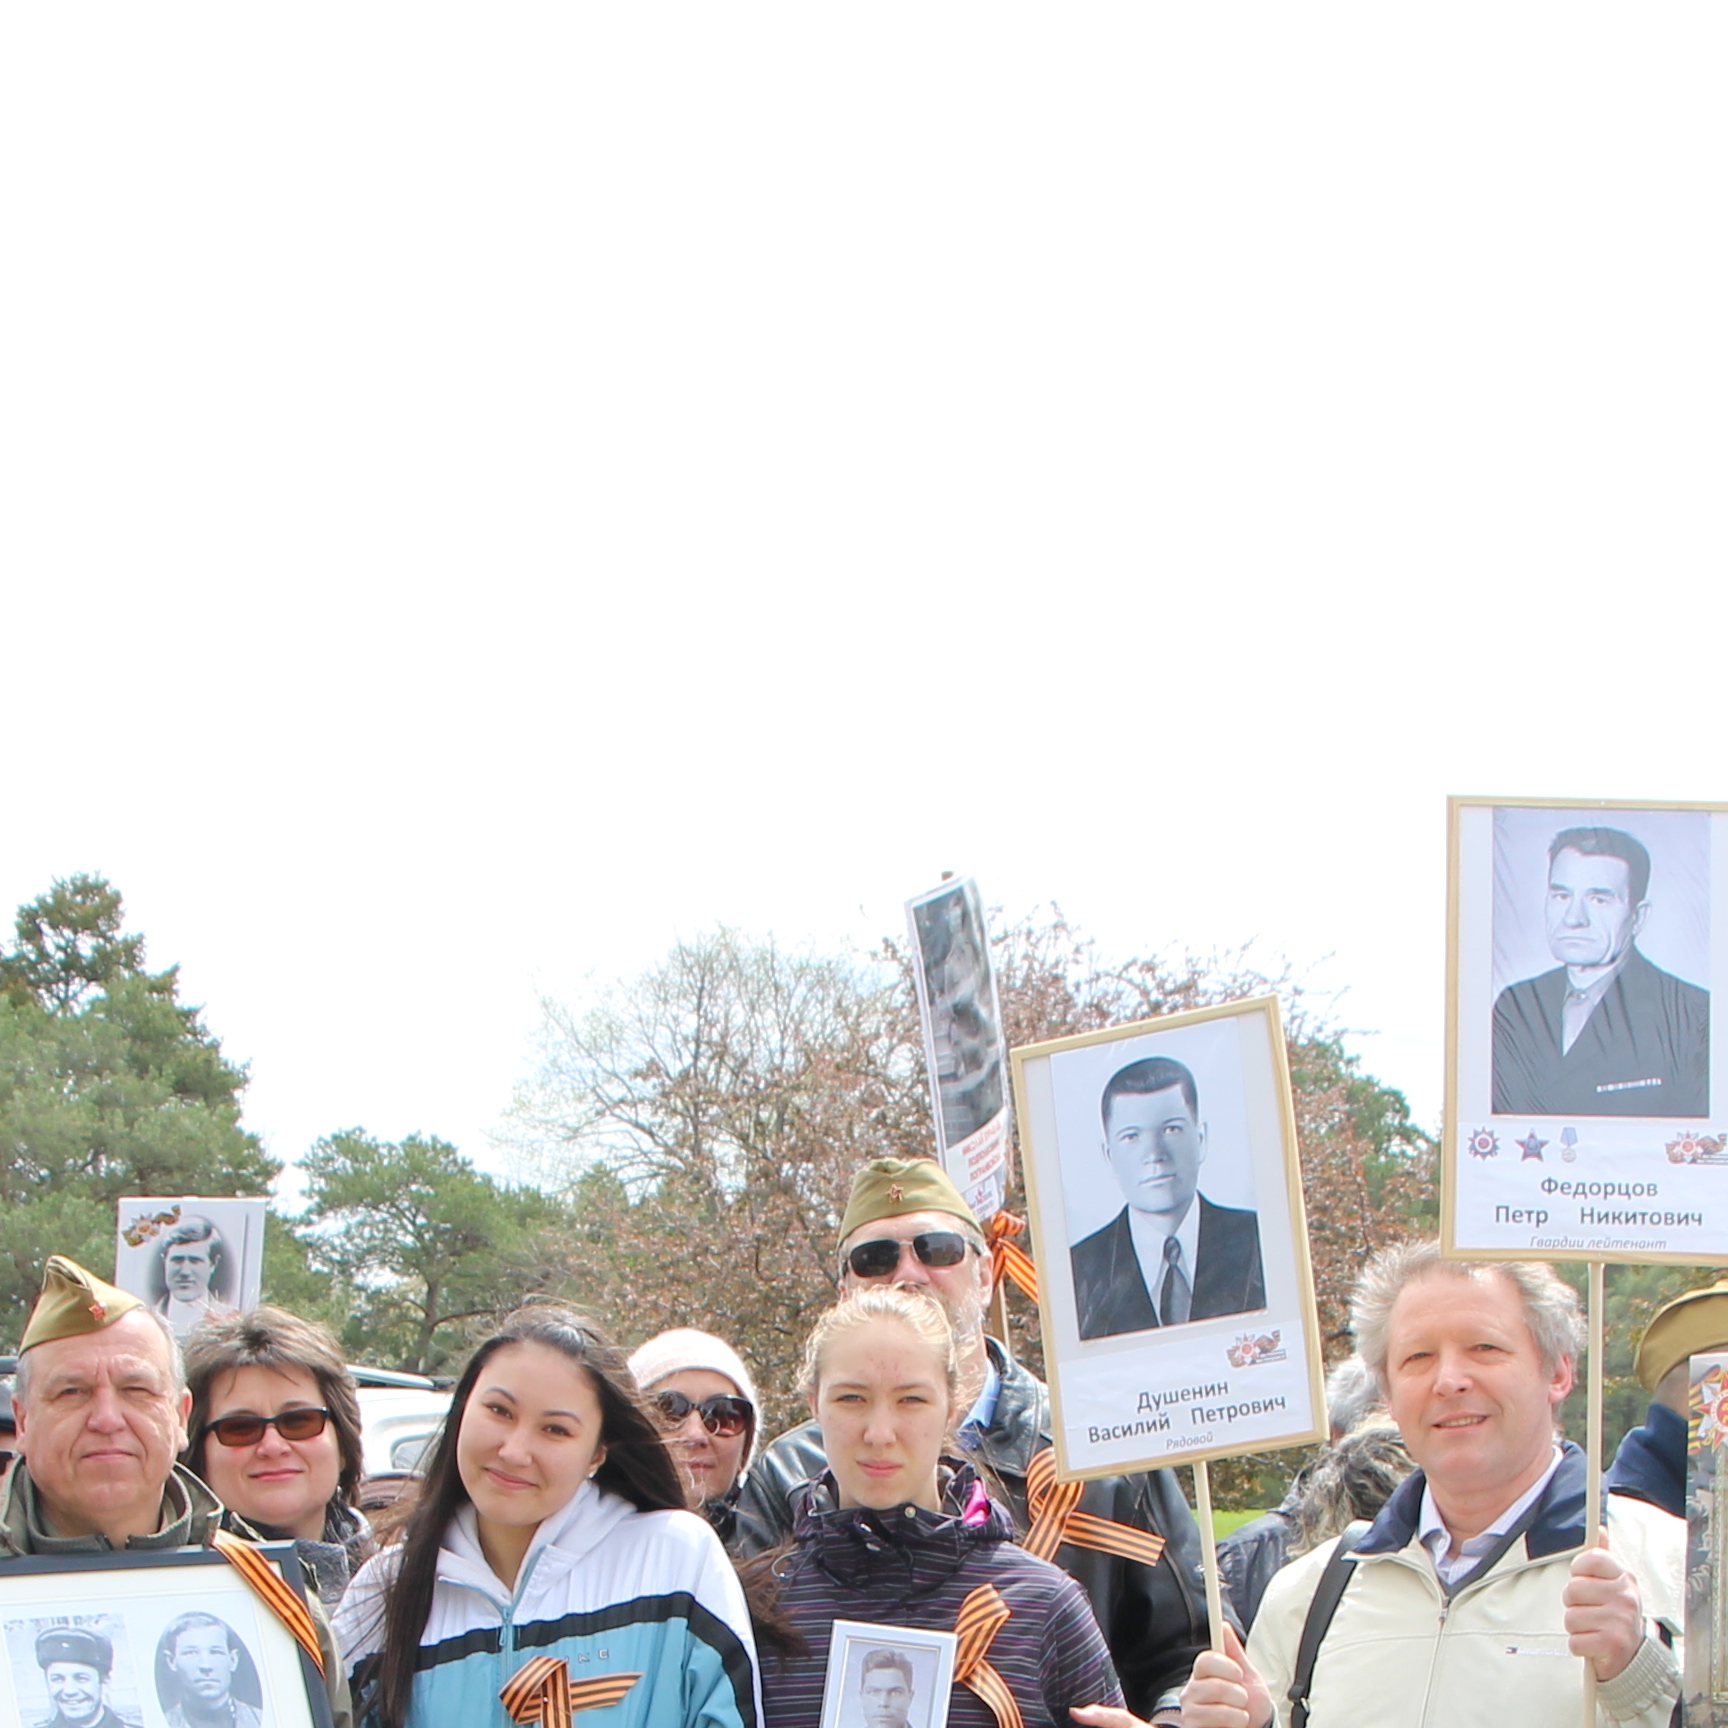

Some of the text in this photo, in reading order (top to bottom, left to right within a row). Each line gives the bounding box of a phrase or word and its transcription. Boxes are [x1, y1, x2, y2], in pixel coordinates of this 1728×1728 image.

[1540, 1177, 1658, 1200] Федорцов
[1495, 1205, 1703, 1228] Петр Никитович
[1530, 1236, 1667, 1249] Гвардии лейтенант
[1137, 1381, 1229, 1414] Душенин
[1088, 1395, 1286, 1444] Василий Петрович
[1166, 1431, 1214, 1450] Рядовой
